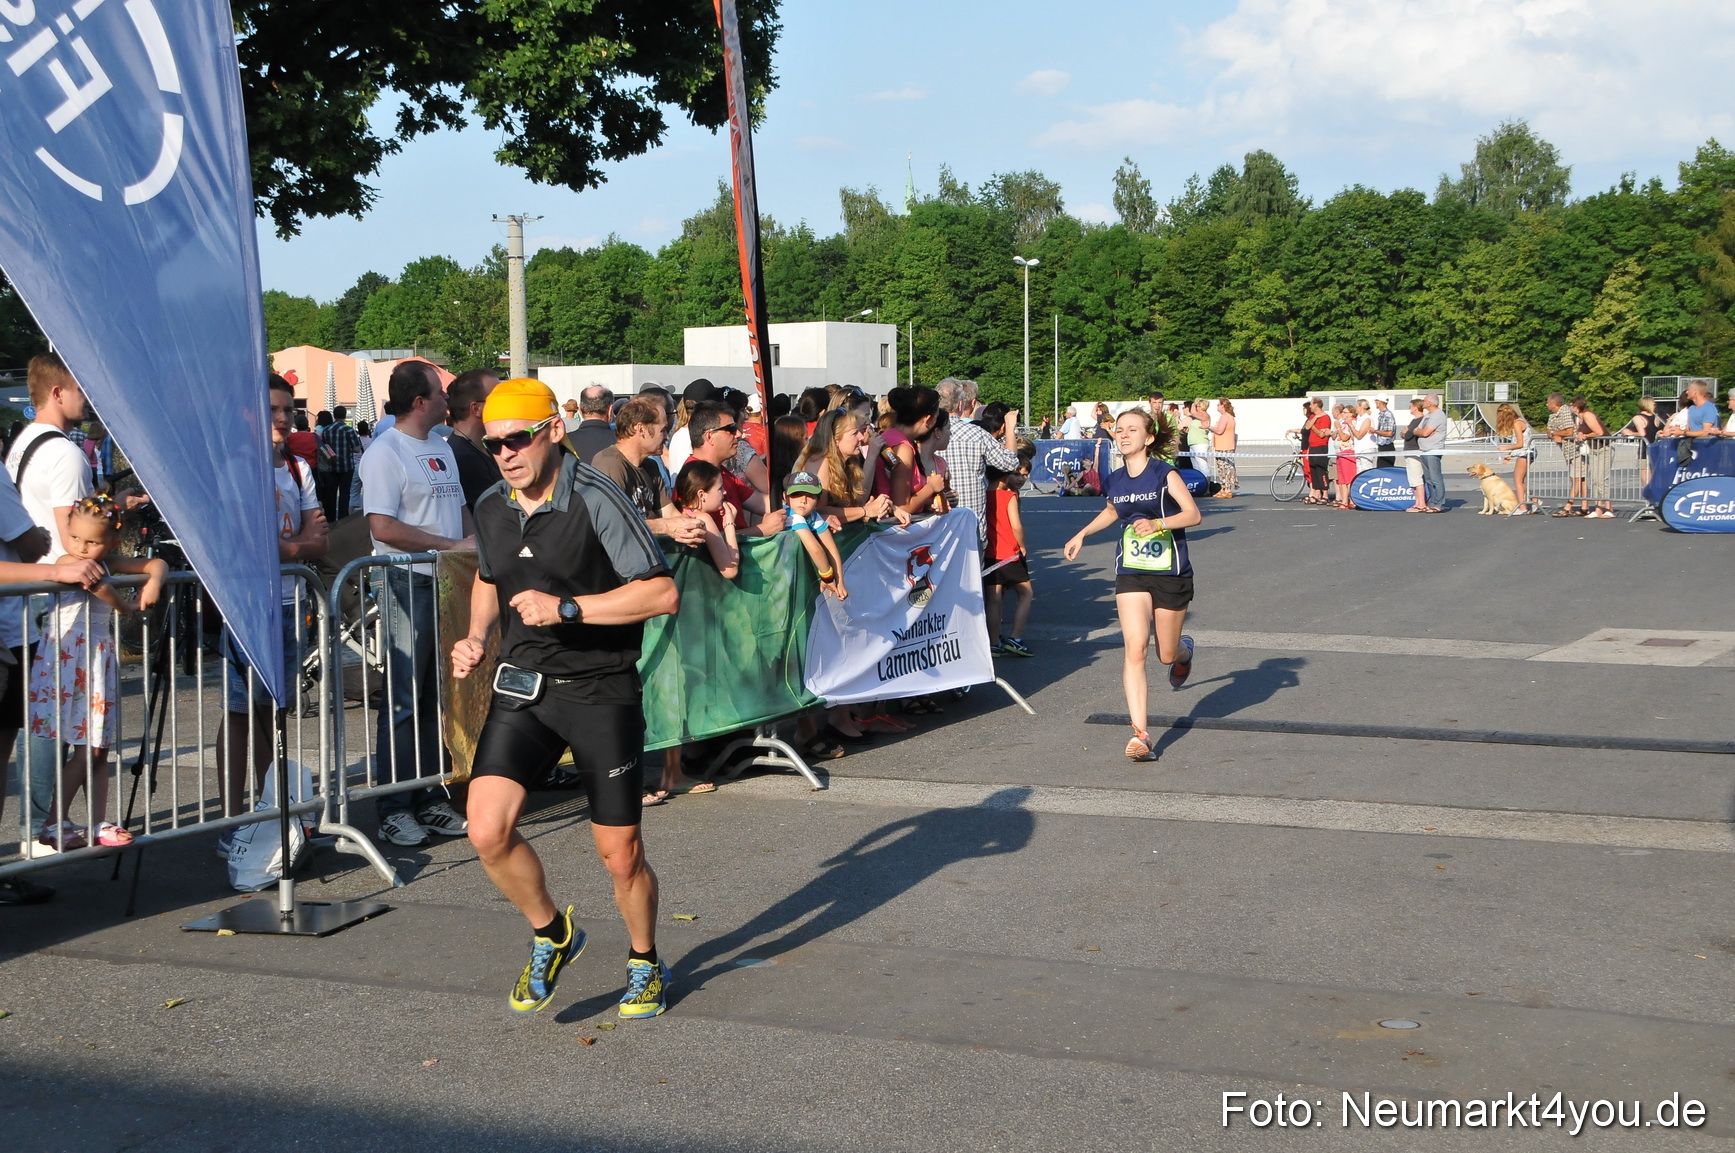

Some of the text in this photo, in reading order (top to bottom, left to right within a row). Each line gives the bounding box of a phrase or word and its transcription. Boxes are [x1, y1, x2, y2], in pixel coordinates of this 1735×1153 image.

[1369, 486, 1415, 497] Fische
[1131, 540, 1163, 558] 349
[877, 634, 961, 681] Lammsbräu
[608, 755, 638, 778] 2XU
